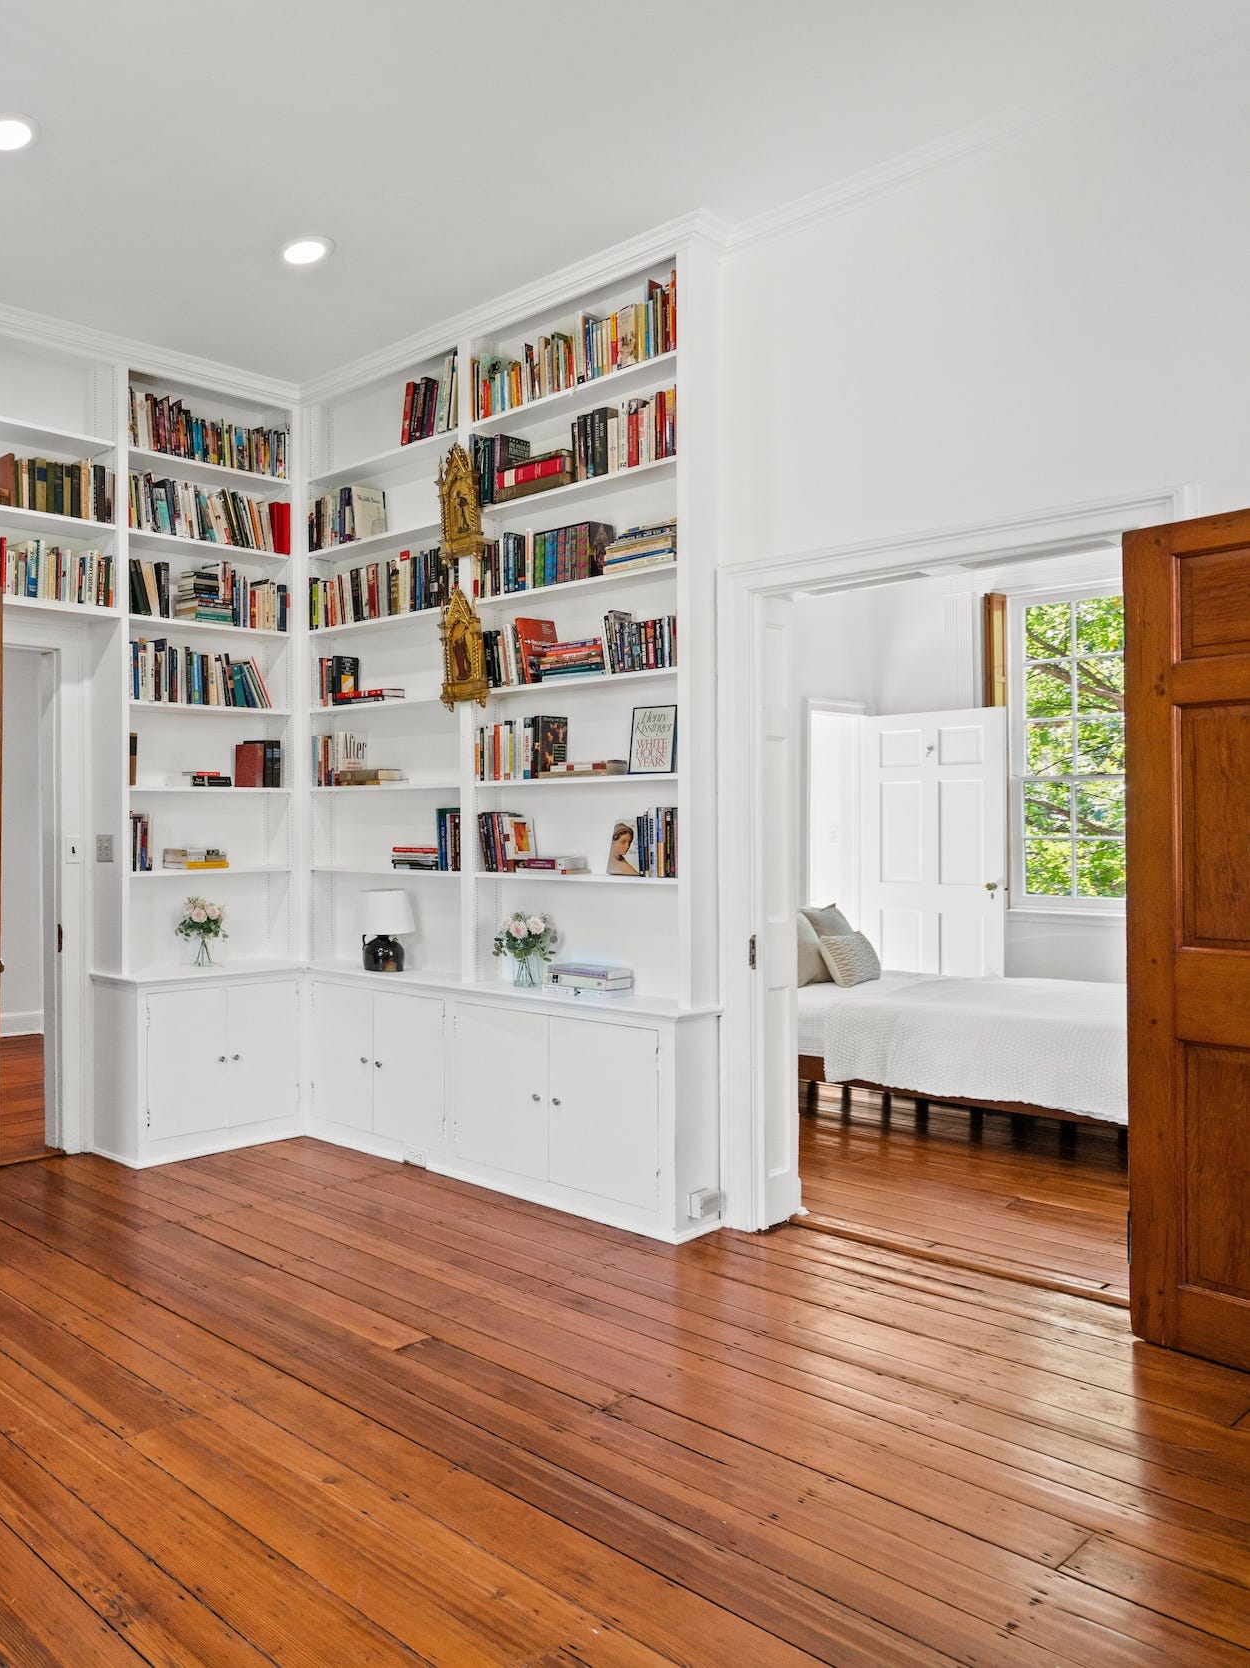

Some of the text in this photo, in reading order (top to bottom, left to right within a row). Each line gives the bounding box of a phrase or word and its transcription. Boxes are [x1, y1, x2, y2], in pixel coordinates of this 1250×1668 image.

[642, 711, 669, 724] Henry
[635, 722, 673, 738] Kissinger
[342, 733, 367, 759] After
[636, 739, 668, 749] WHITE
[635, 748, 668, 758] HOUSE
[637, 757, 665, 768] YEARS
